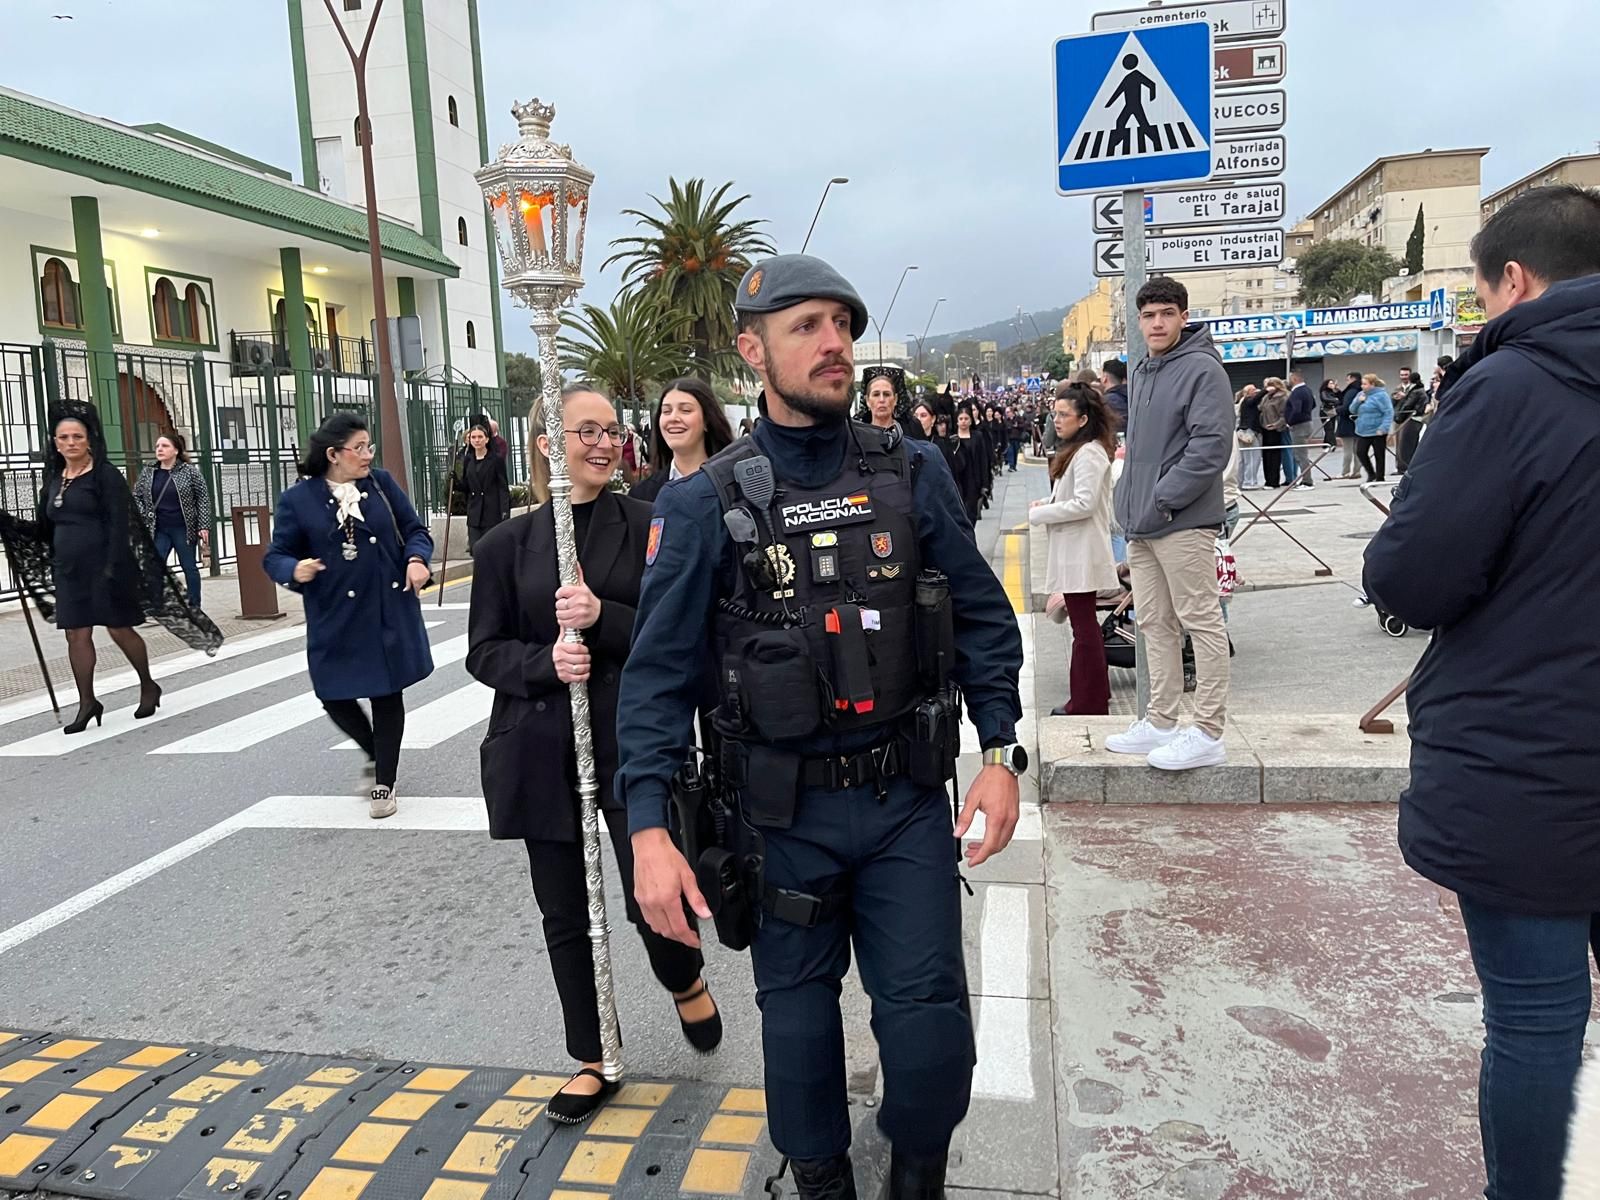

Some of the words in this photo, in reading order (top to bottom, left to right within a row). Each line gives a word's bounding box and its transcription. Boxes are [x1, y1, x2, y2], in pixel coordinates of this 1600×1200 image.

[1140, 9, 1207, 25] cementerio
[1230, 141, 1280, 154] barriada
[1215, 156, 1280, 170] Alfonso
[1178, 193, 1216, 204] centro
[1224, 190, 1239, 200] de
[1246, 187, 1280, 199] salud
[1194, 204, 1209, 217] El
[1220, 199, 1279, 215] Tarajal
[1220, 232, 1279, 246] industrial
[1194, 250, 1209, 263] El
[1220, 245, 1279, 261] Tarajal
[782, 497, 851, 517] POLICIA
[784, 505, 872, 527] NACIONAL
